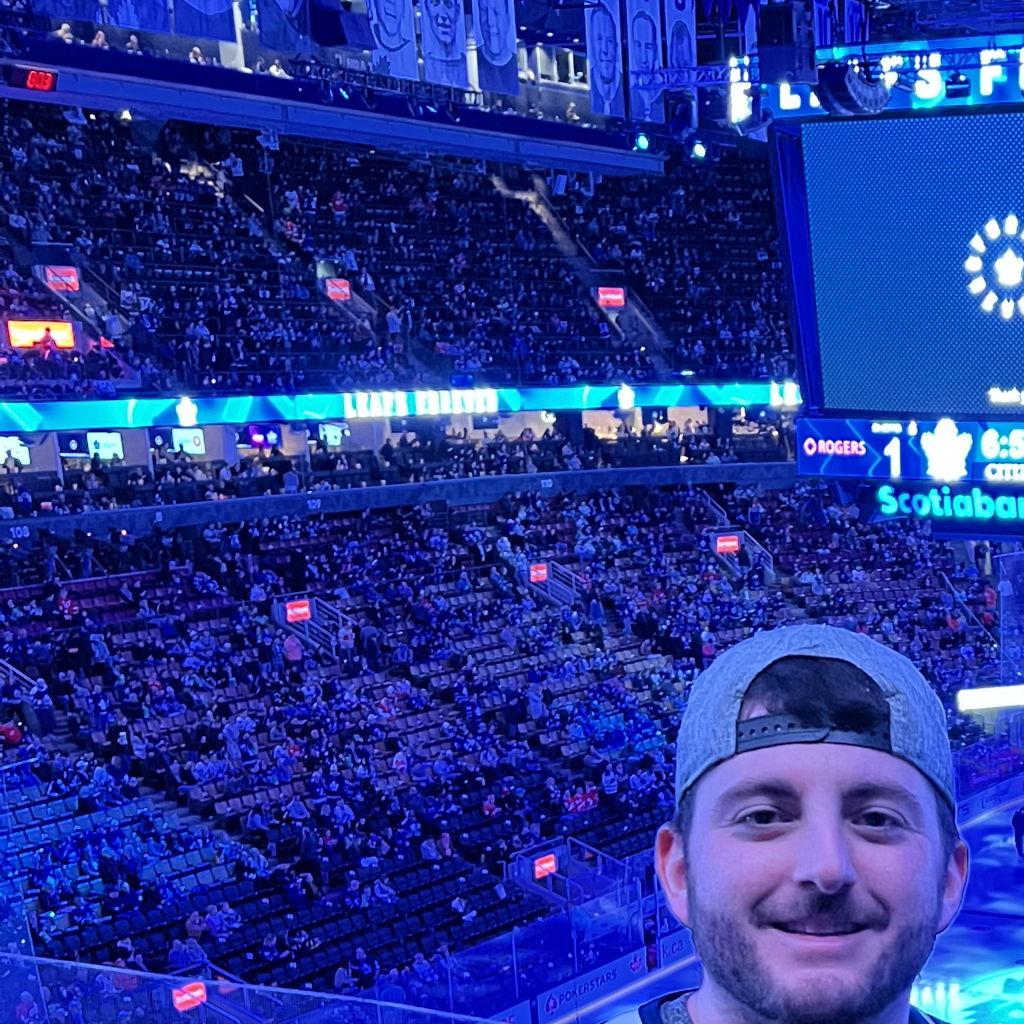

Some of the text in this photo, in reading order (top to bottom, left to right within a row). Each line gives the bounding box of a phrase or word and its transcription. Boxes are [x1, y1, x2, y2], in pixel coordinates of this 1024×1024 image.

[817, 439, 866, 456] ROGERS
[883, 437, 901, 477] 1
[558, 968, 618, 1005] POKERSTARS
